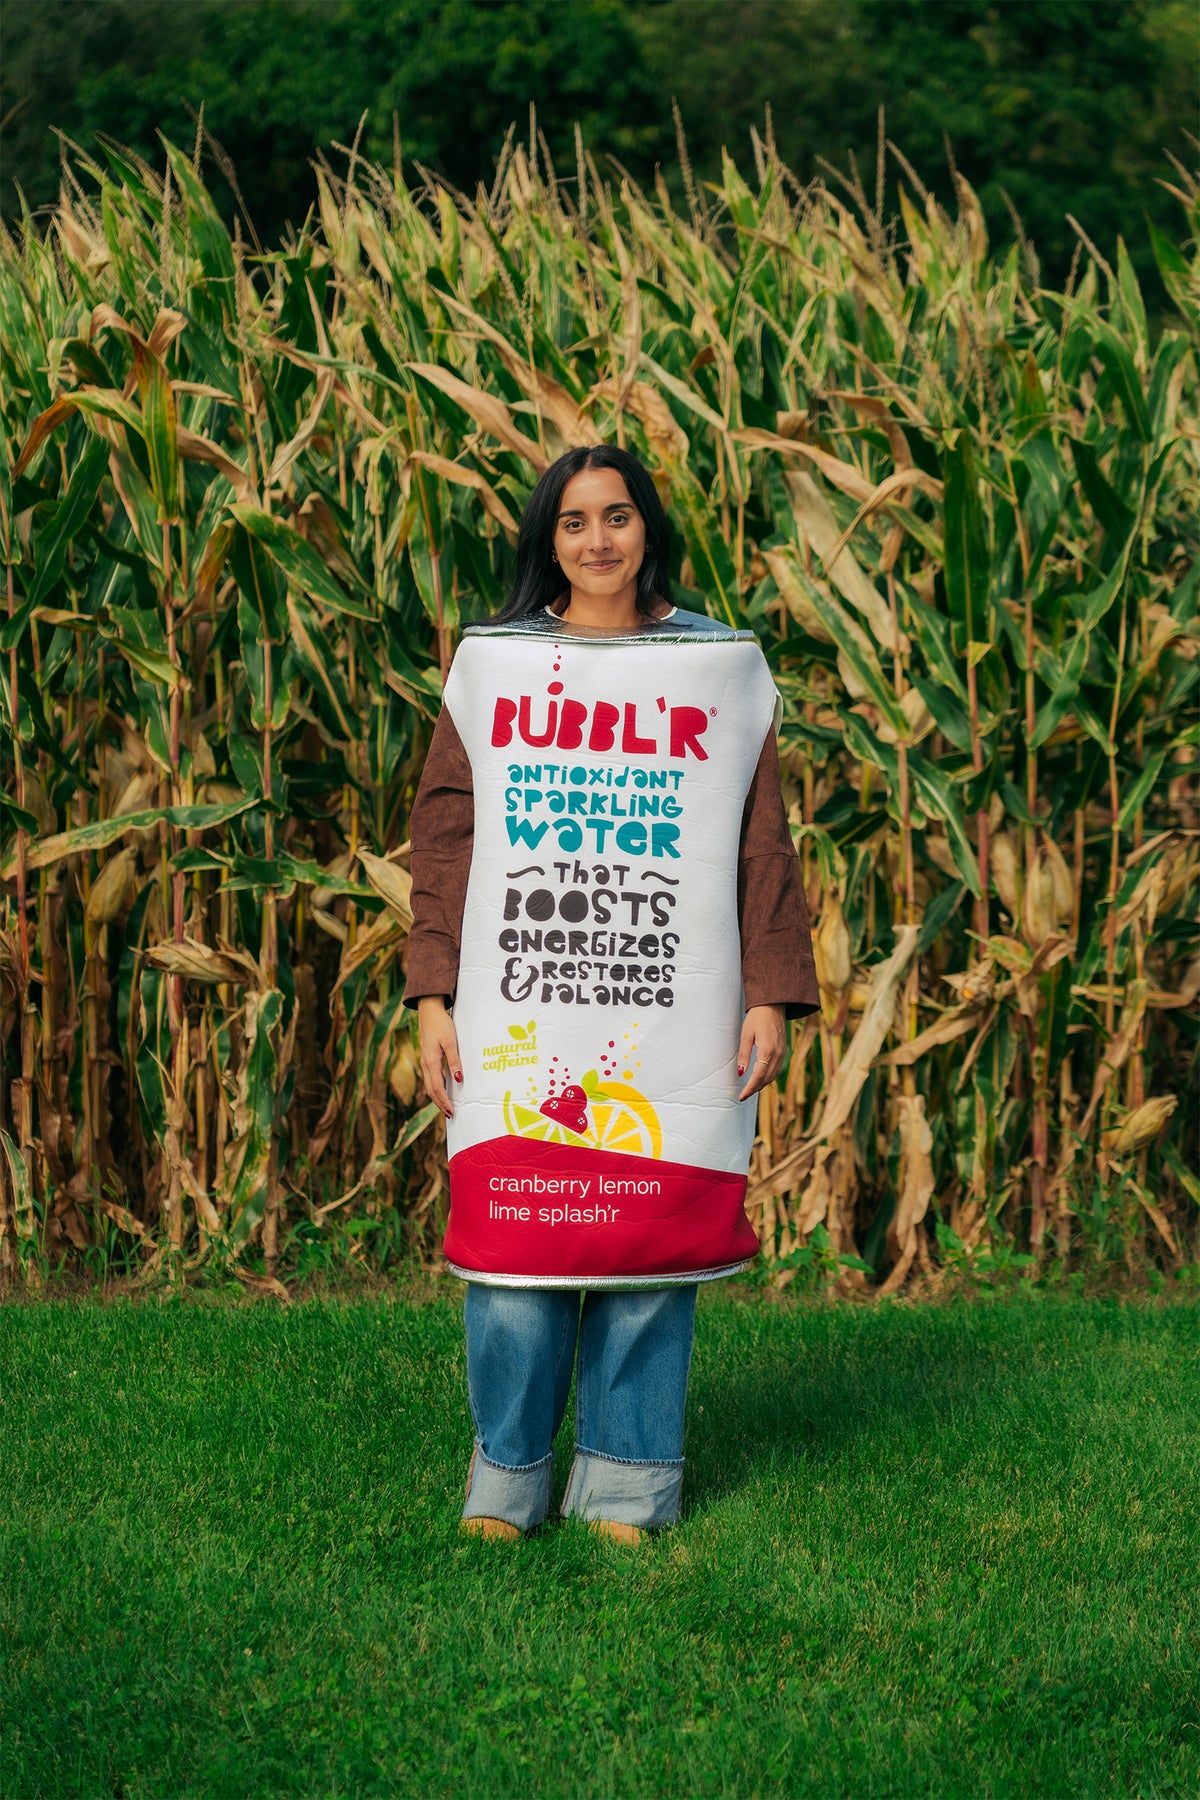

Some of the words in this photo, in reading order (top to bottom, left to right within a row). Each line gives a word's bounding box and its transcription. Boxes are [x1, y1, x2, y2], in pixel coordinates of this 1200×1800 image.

[502, 887, 677, 928] BOOSTS
[499, 956, 541, 1003] &
[482, 1034, 539, 1058] natural
[482, 1052, 540, 1073] caffeine
[488, 1173, 592, 1199] cranberry
[597, 1175, 662, 1196] lemon
[488, 1200, 531, 1221] lime
